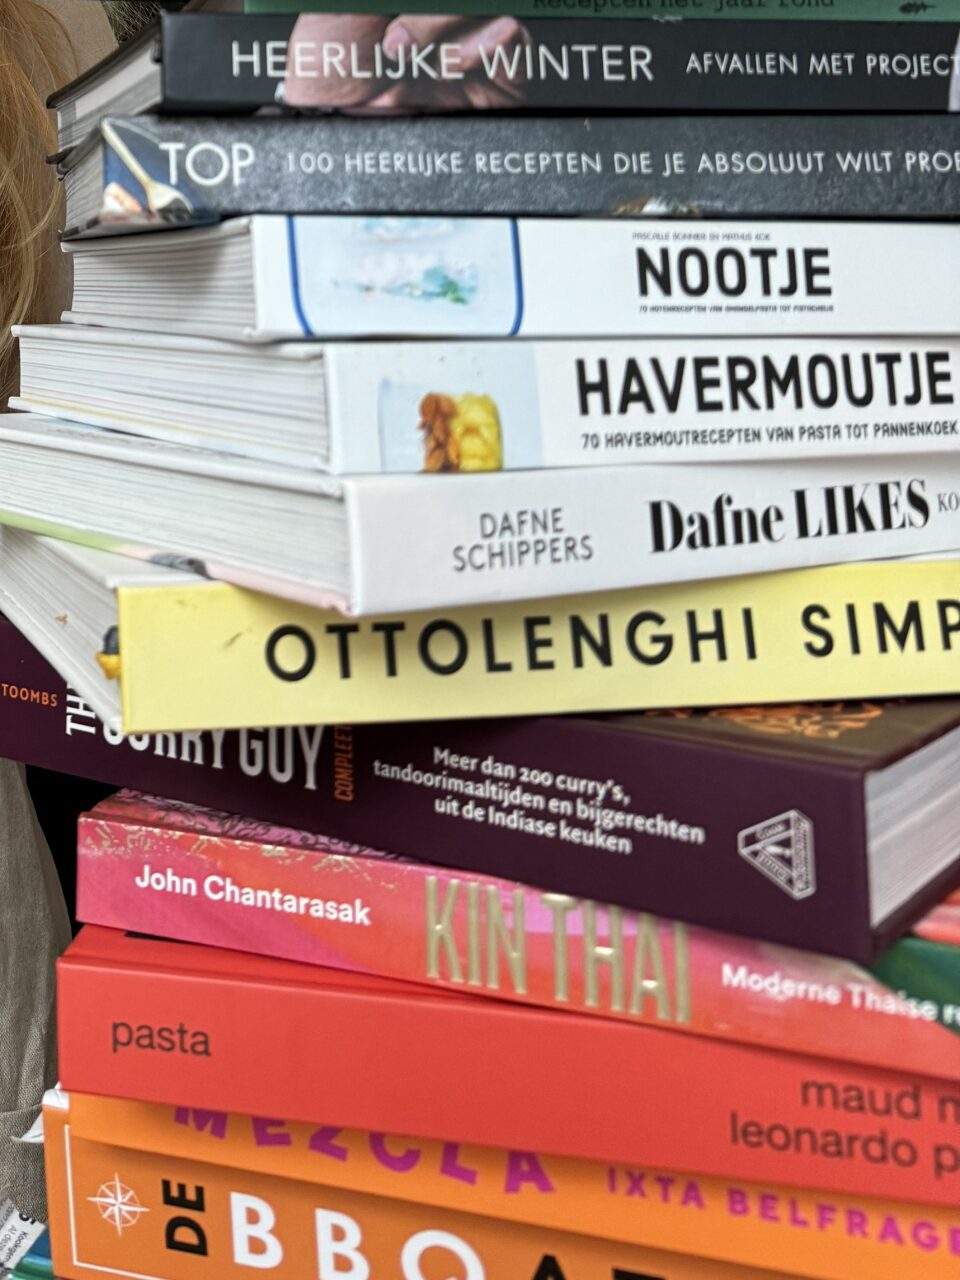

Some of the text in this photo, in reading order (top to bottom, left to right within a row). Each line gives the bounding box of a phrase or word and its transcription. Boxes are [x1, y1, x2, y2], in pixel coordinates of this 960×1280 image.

[232, 40, 654, 81] HEERLIJKE WINTER
[686, 52, 960, 79] AFVALLEN MET PROJECT
[158, 141, 256, 187] TOP
[286, 151, 334, 174] 100
[344, 151, 463, 177] HEERLIJKE
[475, 151, 602, 175] RECEPTEN
[613, 151, 653, 174] DIE
[662, 151, 686, 177] JE
[697, 151, 826, 174] ABSOLUUT
[836, 151, 892, 174] WILT
[636, 247, 832, 296] NOOTJE
[575, 351, 955, 416] HAVERMOUTJE
[581, 420, 958, 449] 70 HAVERMOUTRECEPTEN VAN PASTA TOT PANNENKOEK
[480, 508, 565, 539] DAFNE
[648, 493, 785, 554] Dafne
[791, 478, 931, 540] LIKES
[453, 535, 594, 572] SCHIPPERS
[266, 599, 960, 682] OTTOLENGHI SIMP
[2, 683, 58, 708] TOOMBS
[65, 683, 96, 736] TH
[239, 724, 324, 790] GUY
[434, 746, 632, 807] Meer dan 200 curry's,
[373, 760, 545, 810] tandoorimaaltijden
[548, 797, 572, 813] en
[576, 798, 706, 845] bijgerechten
[435, 796, 632, 855] uit de Indiase keuken
[135, 864, 371, 926] John Chantarasak
[425, 874, 693, 1024] KIN THAI
[721, 962, 841, 1006] Moderne
[845, 982, 939, 1021] Thaise
[111, 1021, 211, 1057] pasta
[801, 1079, 922, 1121] maud
[730, 1111, 918, 1168] leonardo
[161, 1179, 209, 1257] DE
[607, 1167, 706, 1209] IXTA
[727, 1187, 960, 1258] BELFRAGE
